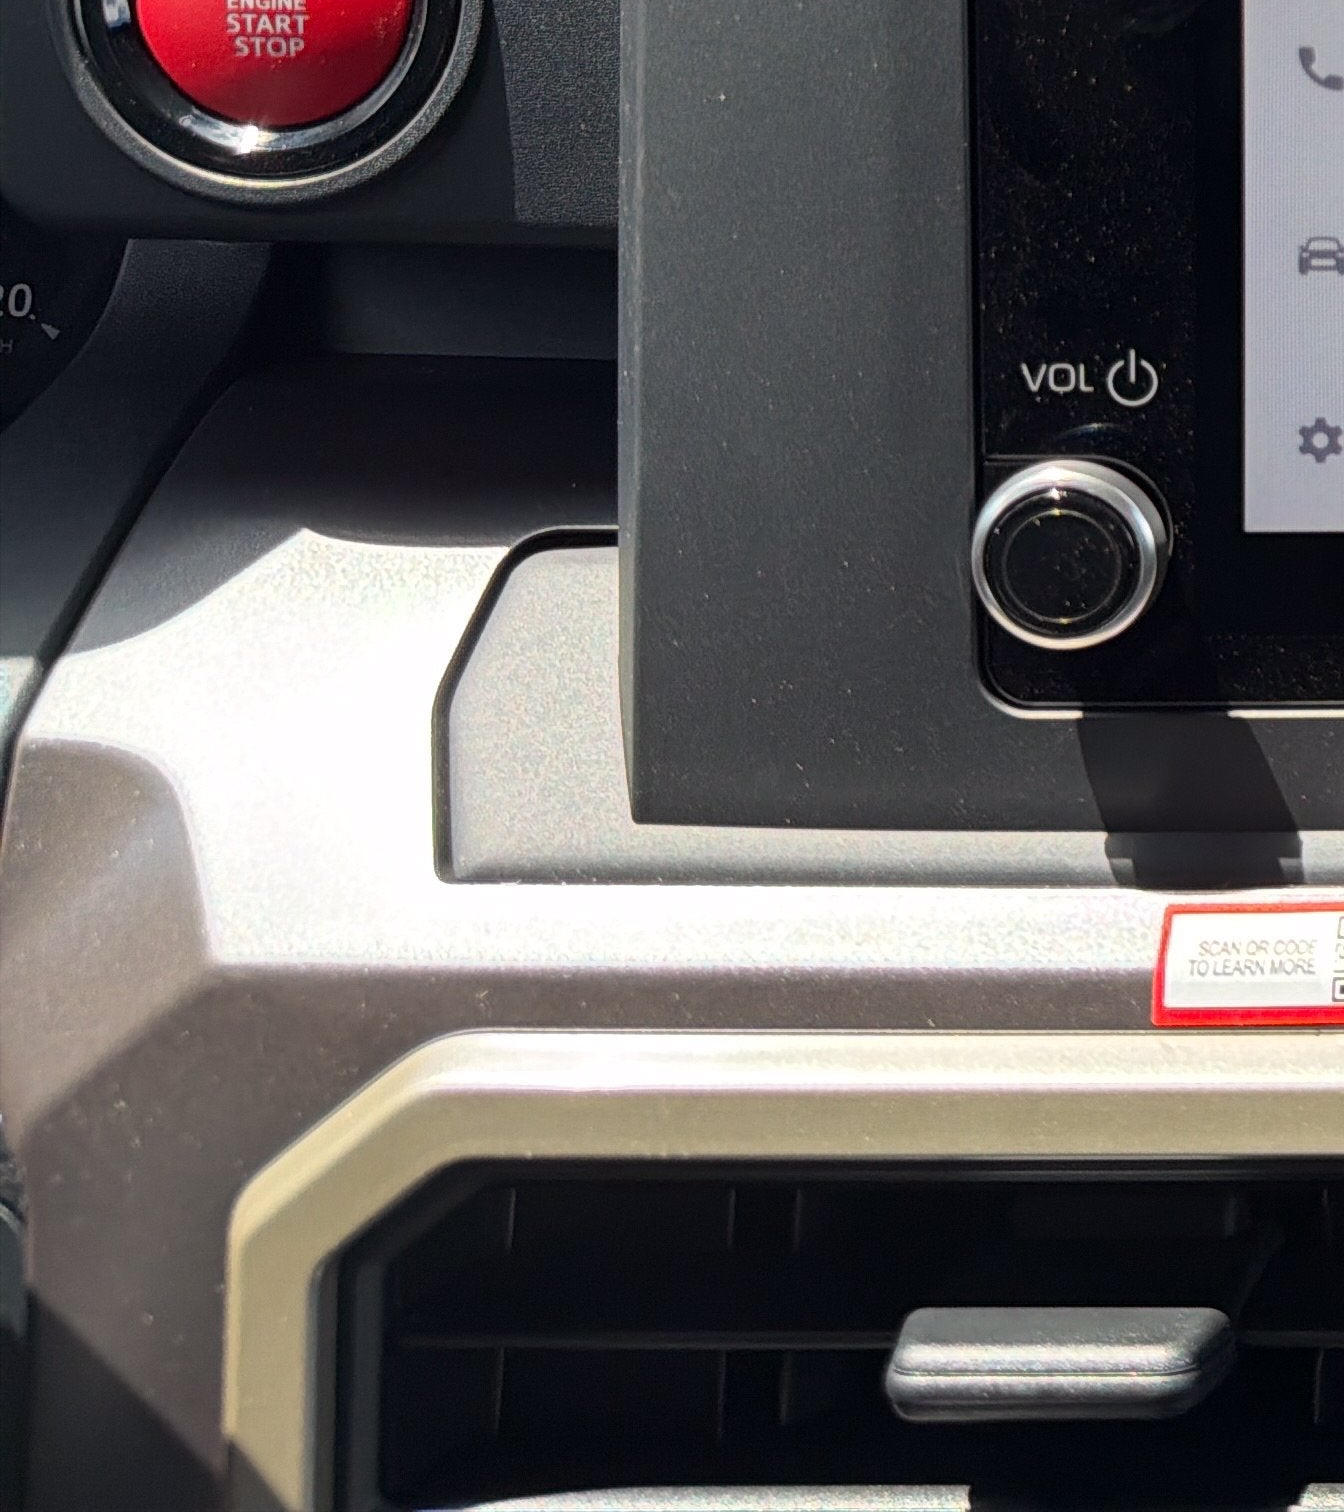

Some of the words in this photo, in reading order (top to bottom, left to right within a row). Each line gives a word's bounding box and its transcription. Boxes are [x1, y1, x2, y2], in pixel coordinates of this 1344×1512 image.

[226, 12, 310, 34] START
[234, 35, 305, 57] STOP
[1020, 362, 1095, 393] VOL
[1199, 939, 1241, 957] SCAN
[1189, 959, 1209, 977] TO
[1212, 959, 1265, 977] LEARN
[1270, 958, 1317, 976] MORE
